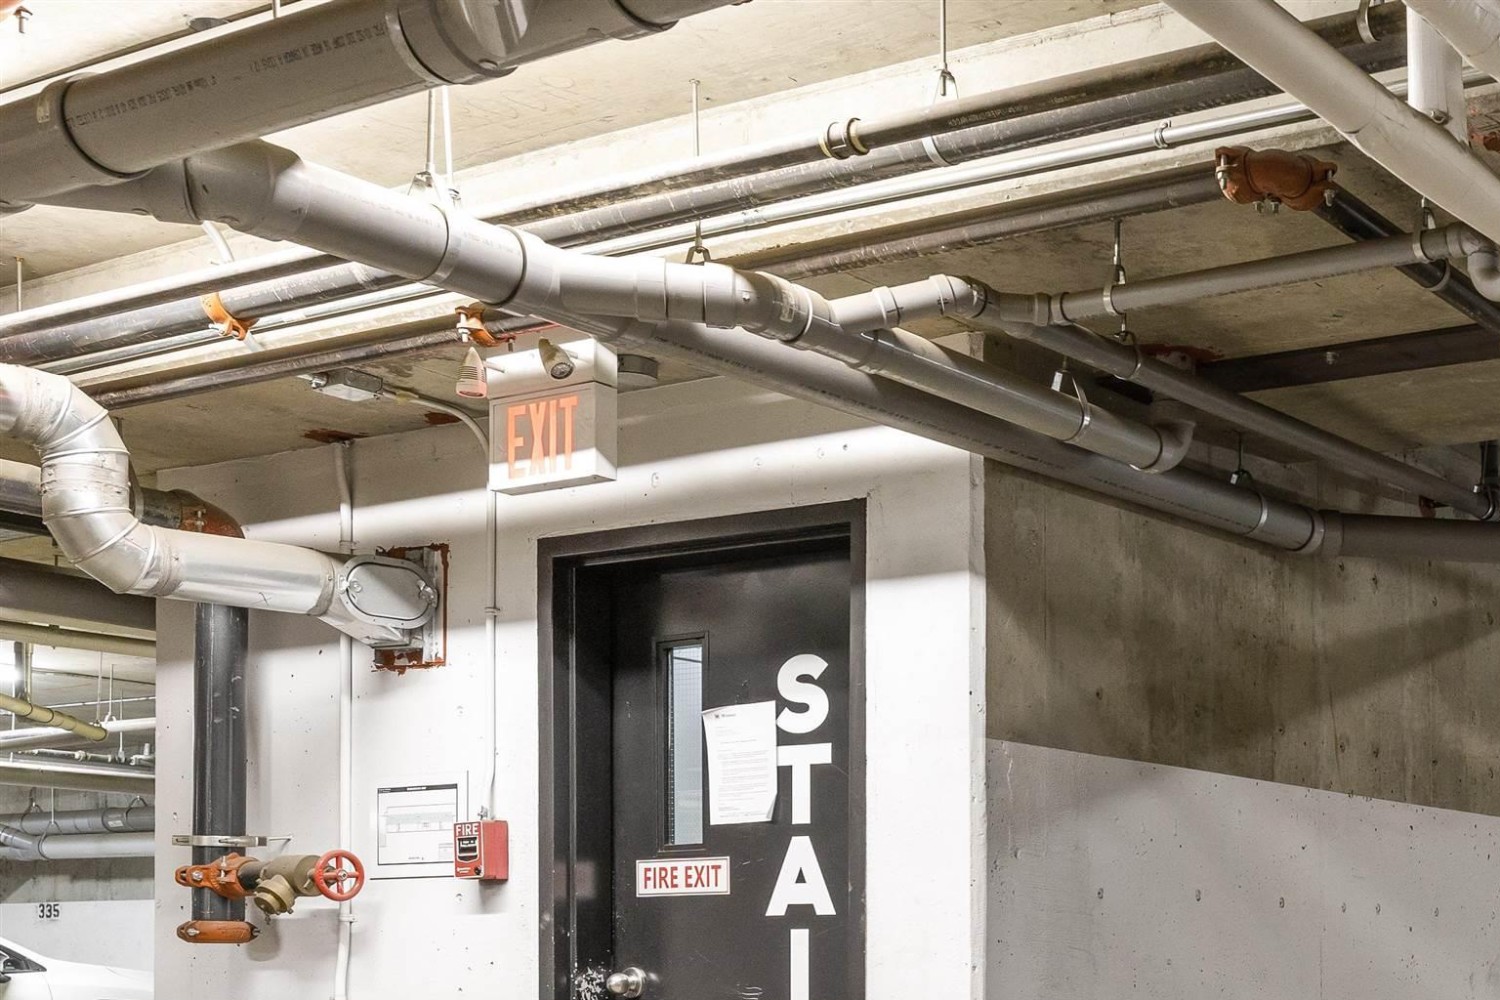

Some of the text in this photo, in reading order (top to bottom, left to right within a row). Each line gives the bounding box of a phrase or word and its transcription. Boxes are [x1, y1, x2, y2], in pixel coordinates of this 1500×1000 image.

[507, 394, 579, 479] EXIT
[456, 823, 479, 836] FIRE
[644, 864, 722, 889] FIRE EXIT
[38, 903, 60, 919] 335
